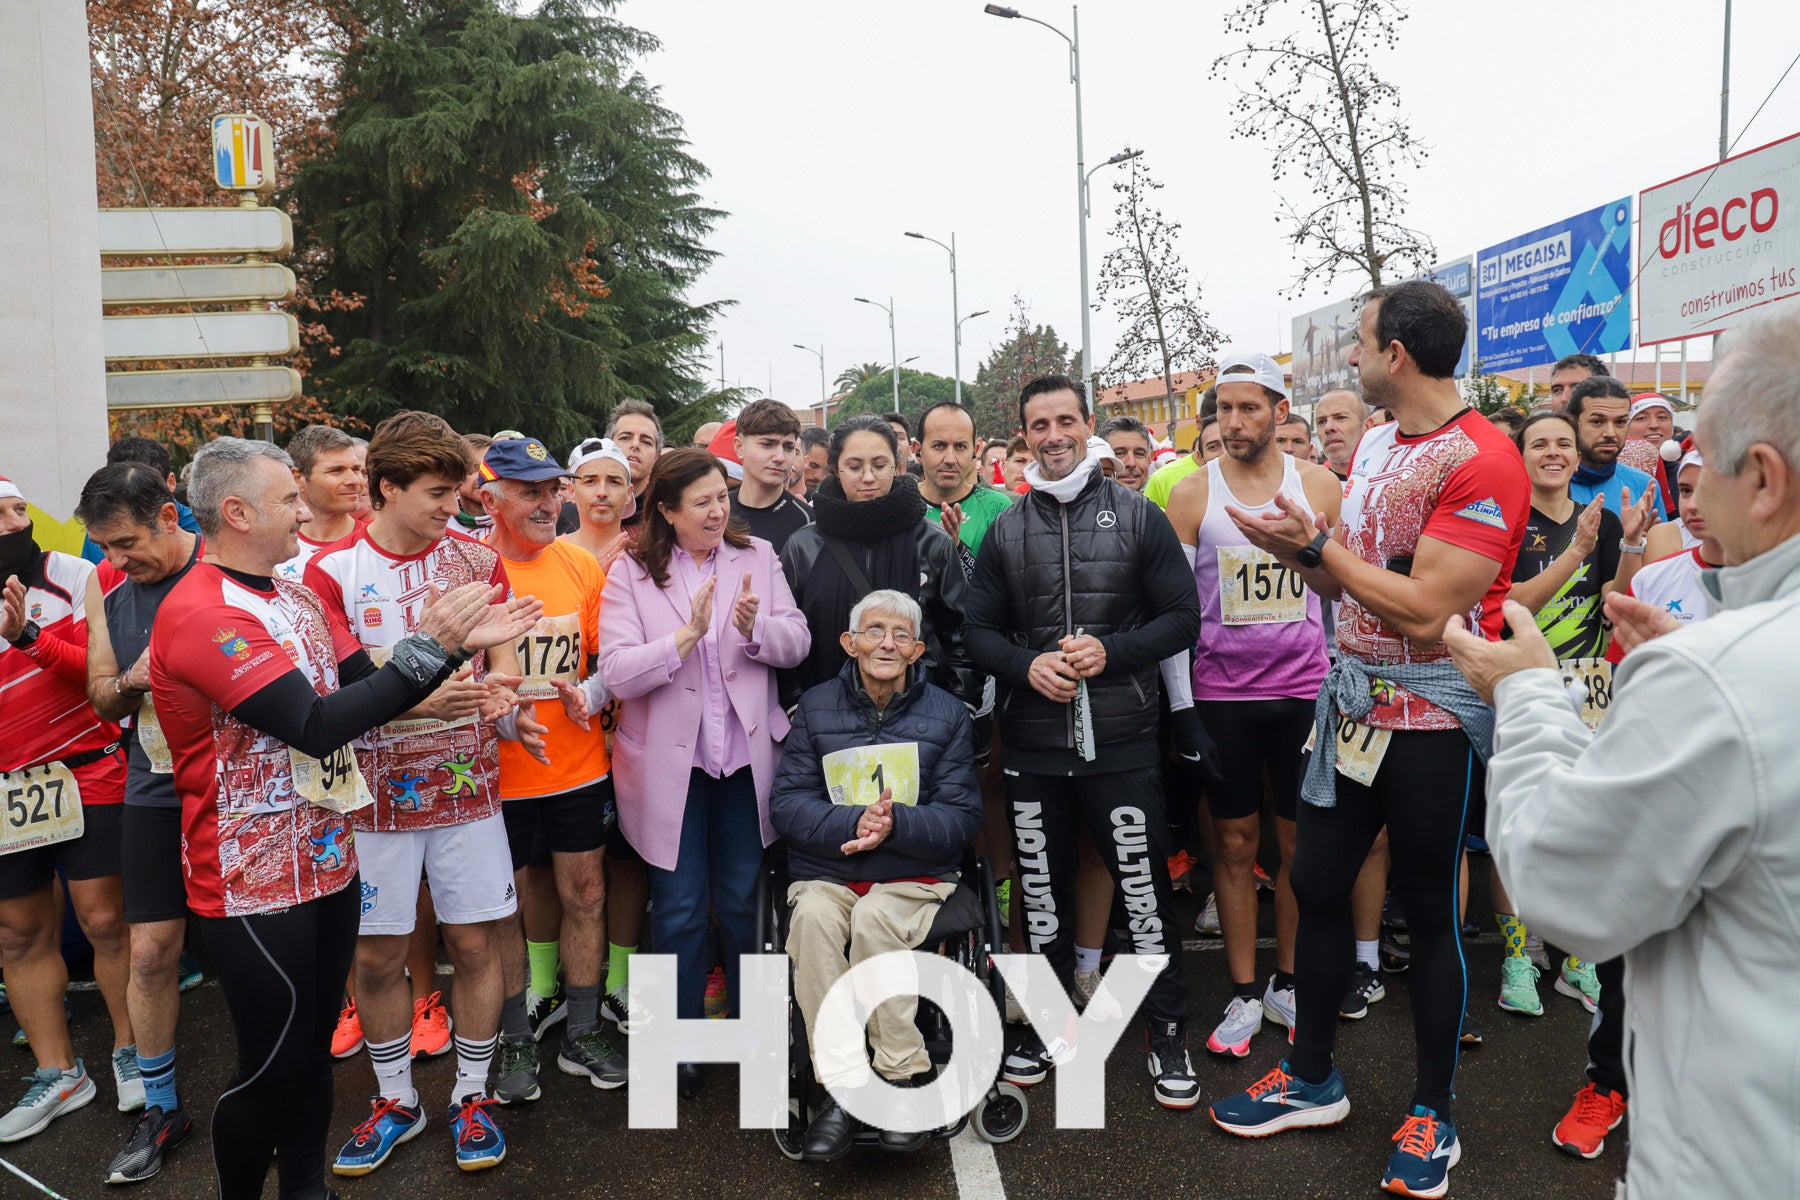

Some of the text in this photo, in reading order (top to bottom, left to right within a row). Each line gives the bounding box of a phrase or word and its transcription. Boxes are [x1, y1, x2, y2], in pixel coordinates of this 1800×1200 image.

[1659, 187, 1779, 259] dieco
[1505, 240, 1567, 275] MEGAISA
[1662, 239, 1773, 278] construcción
[1681, 266, 1796, 318] construimos tus
[1500, 317, 1540, 339] empresa
[1542, 312, 1555, 327] de
[1236, 563, 1304, 601] 1570
[364, 617, 383, 625] KING
[518, 632, 581, 676] 1725
[392, 722, 444, 734] DOMBENITENSE
[871, 764, 885, 796] 1
[8, 779, 64, 828] 527
[0, 837, 49, 852] OMBENITENSE
[1013, 801, 1060, 953] NATURAL
[1110, 806, 1170, 973] CULTURISMO
